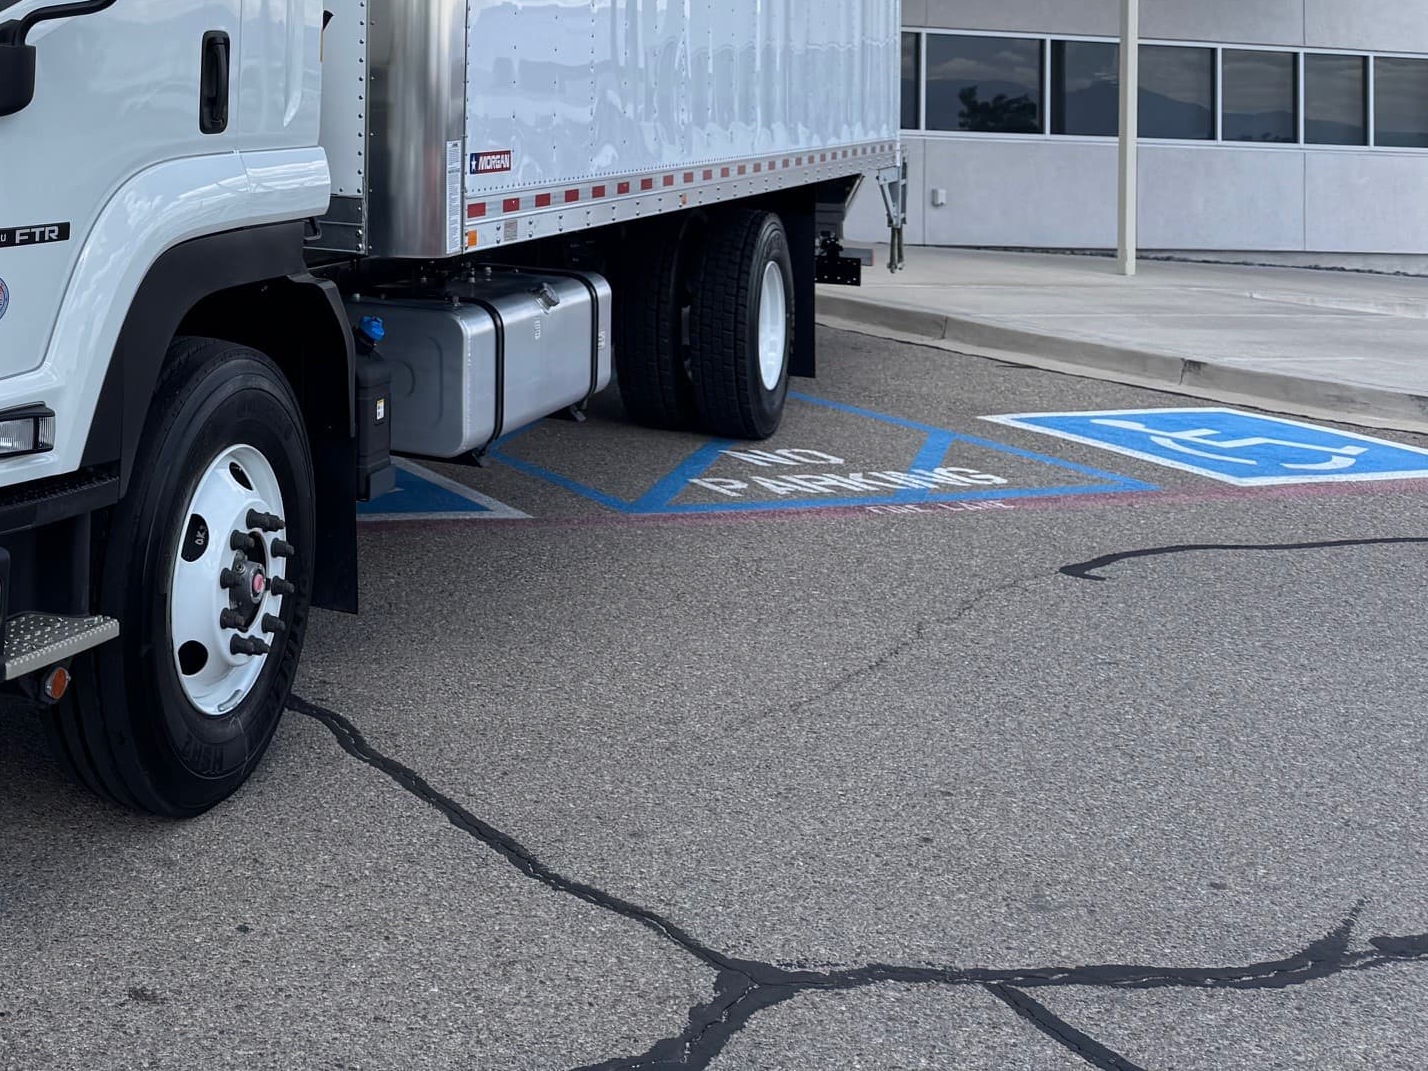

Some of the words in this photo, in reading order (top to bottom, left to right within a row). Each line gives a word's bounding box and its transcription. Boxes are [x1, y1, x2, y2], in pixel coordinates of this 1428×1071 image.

[478, 154, 510, 171] MORGAN
[15, 226, 59, 244] FTR
[718, 448, 845, 467] NO
[688, 466, 1009, 497] PARKING
